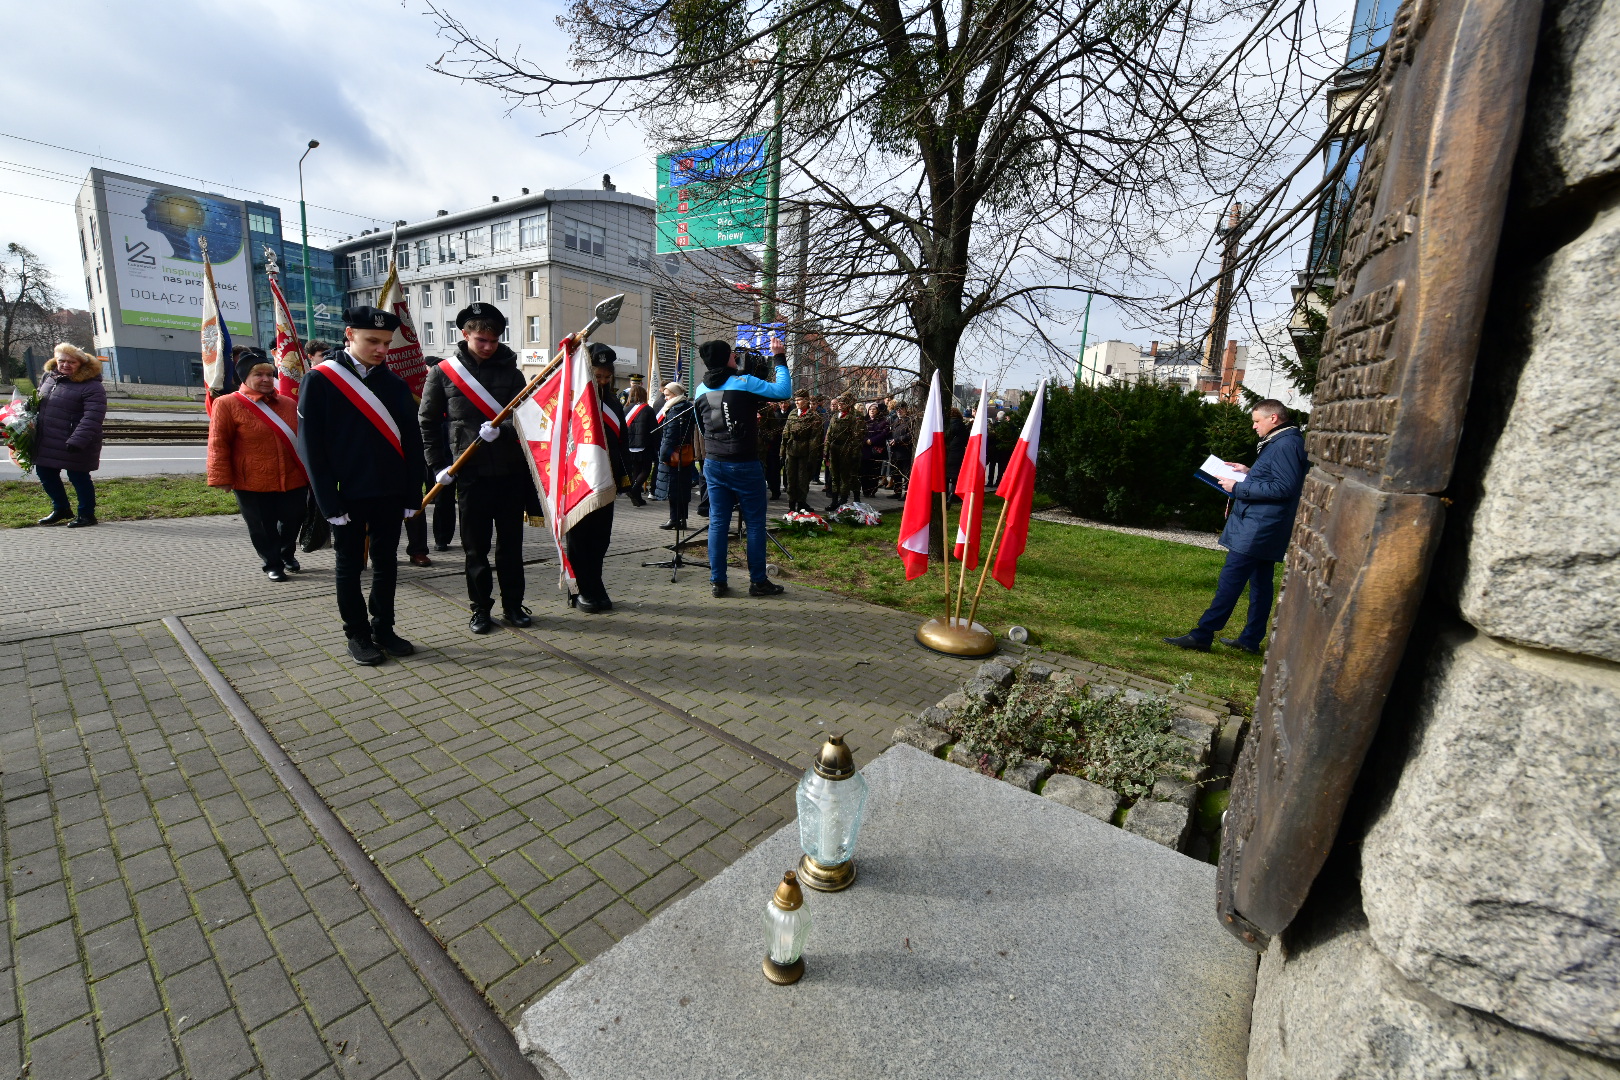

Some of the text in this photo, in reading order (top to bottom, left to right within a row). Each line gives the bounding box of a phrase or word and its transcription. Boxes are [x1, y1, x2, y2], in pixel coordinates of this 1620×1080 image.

[679, 231, 744, 246] 92 Pniewy
[163, 275, 182, 284] nas
[130, 288, 185, 305] DOŁĄCZ
[575, 400, 593, 444] BÓG
